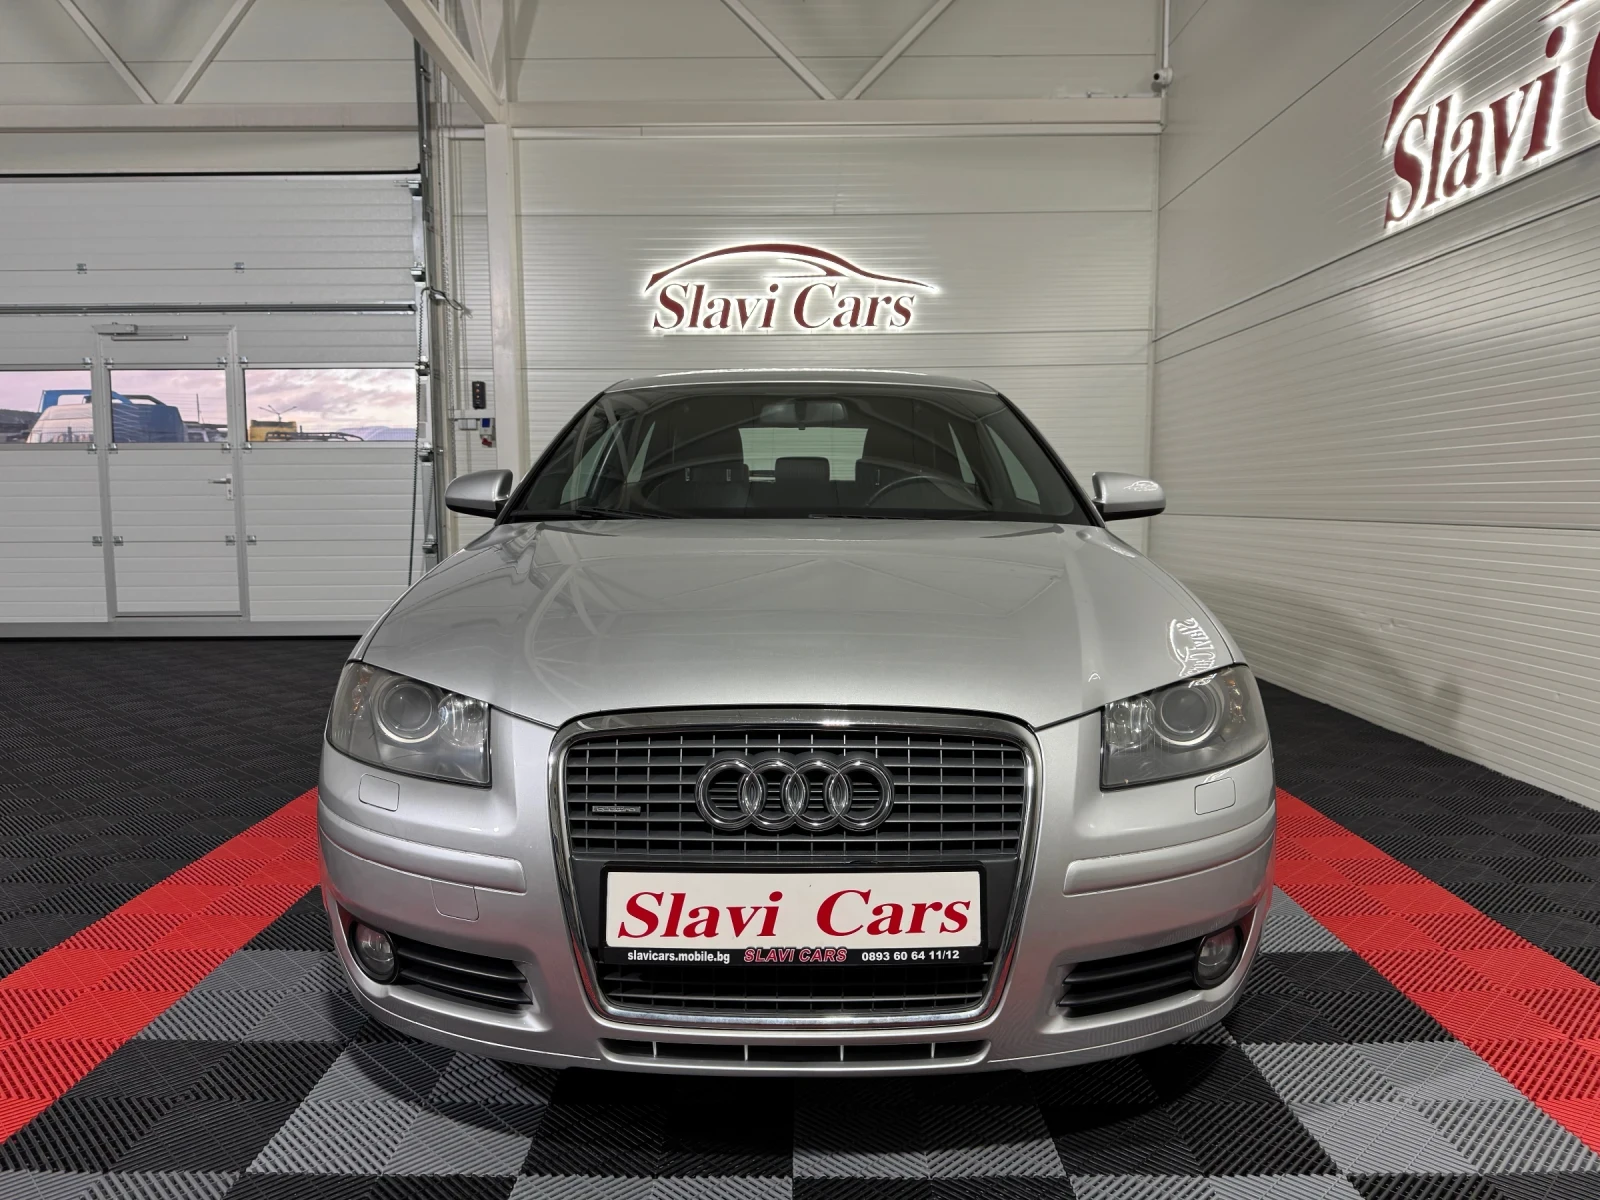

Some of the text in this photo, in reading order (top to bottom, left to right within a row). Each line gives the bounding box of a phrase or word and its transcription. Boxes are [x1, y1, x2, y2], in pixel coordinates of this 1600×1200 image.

[1383, 25, 1564, 228] Slavi
[652, 282, 915, 329] Slavi Cars
[617, 889, 971, 938] Slavi Cars
[627, 949, 960, 964] slavicars.mobile.bg SLAVI CARS 0893 60 64 11/12
